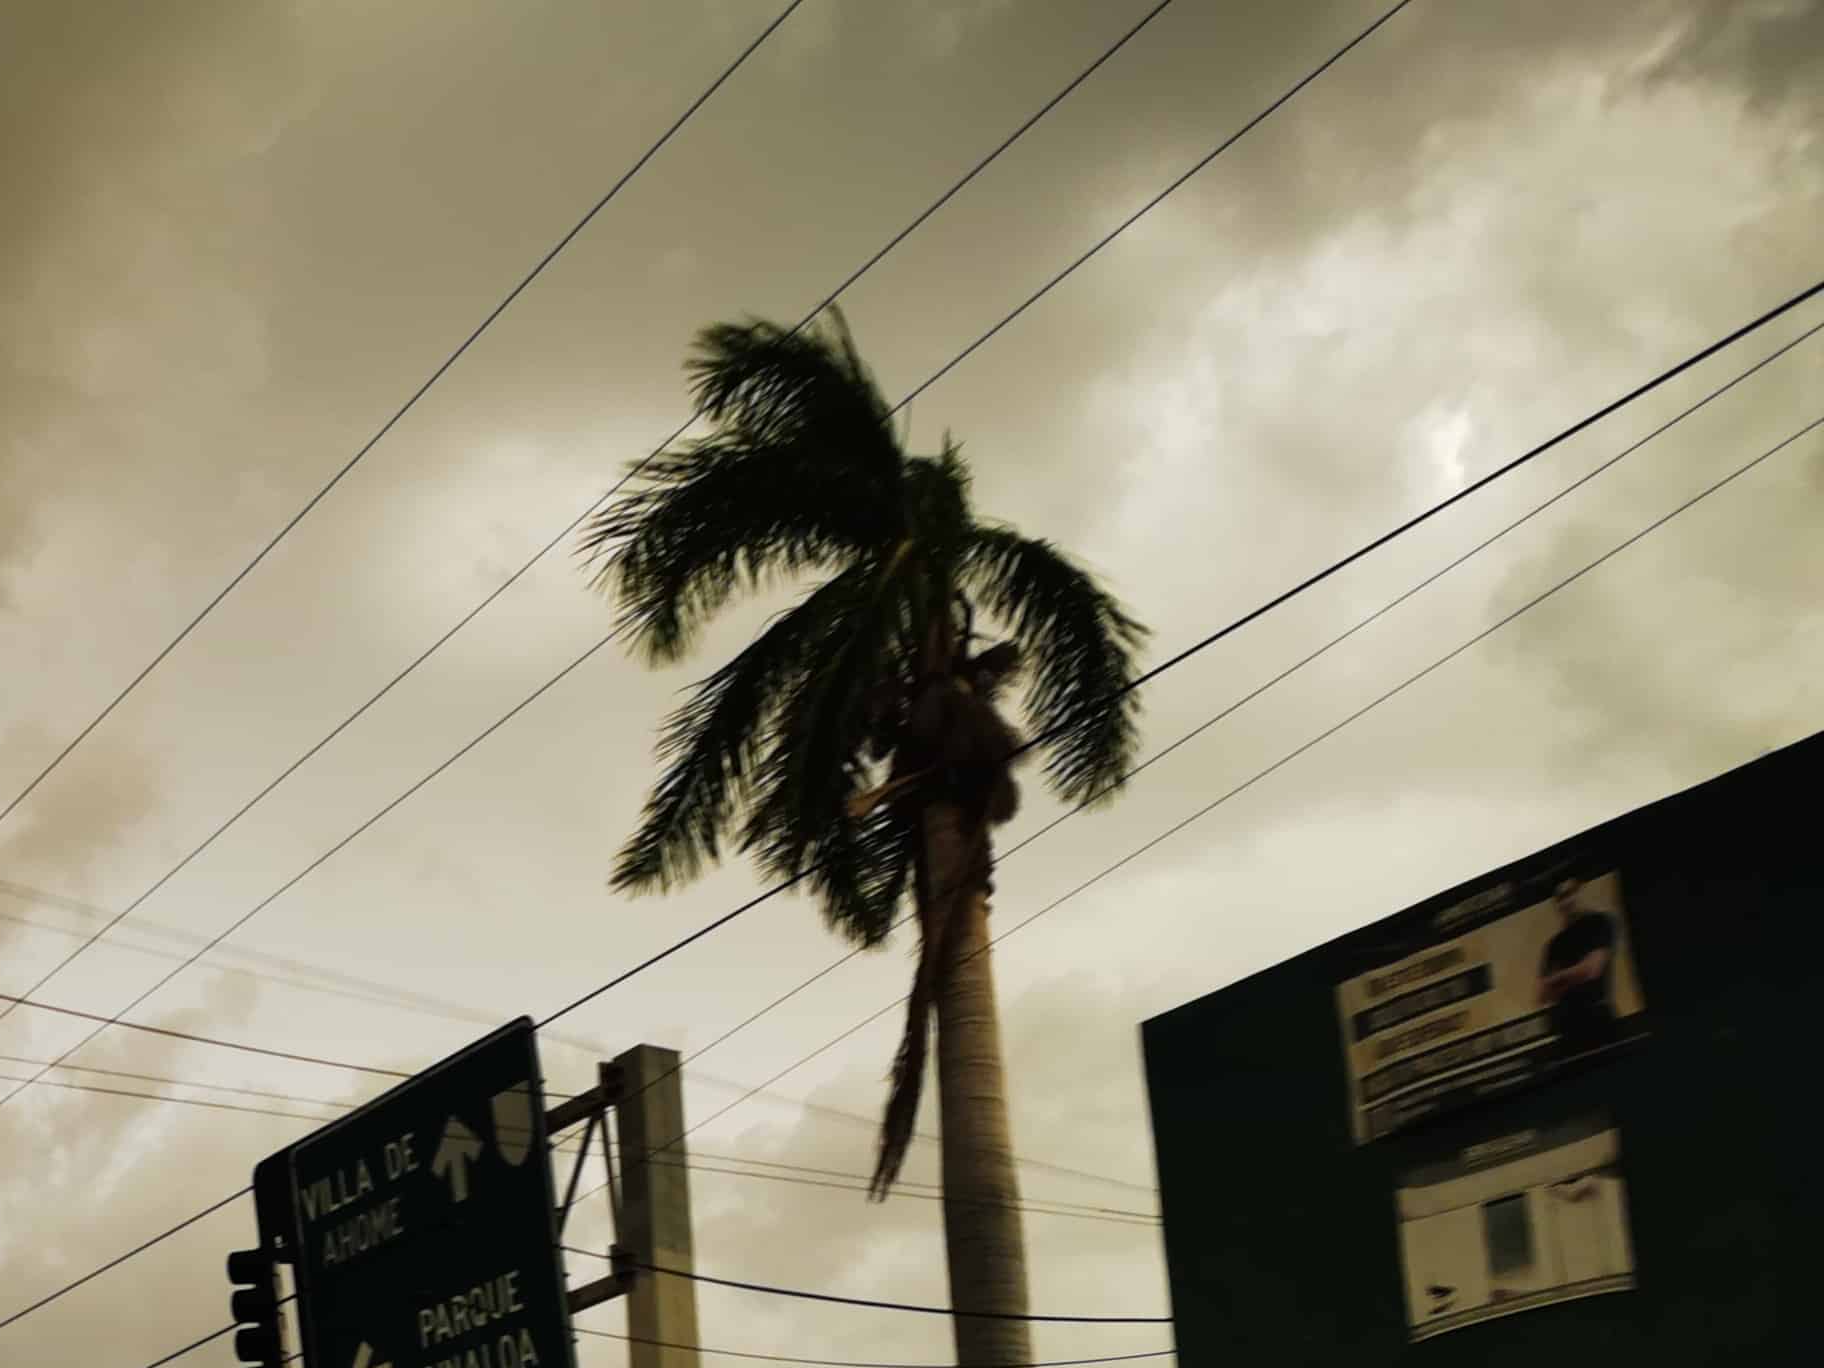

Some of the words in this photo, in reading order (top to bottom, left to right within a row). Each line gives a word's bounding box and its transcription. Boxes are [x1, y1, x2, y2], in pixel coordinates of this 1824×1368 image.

[301, 1159, 374, 1221] VILLA
[384, 1133, 419, 1182] DE
[322, 1199, 404, 1267] AHOME
[418, 1270, 526, 1348] PARQUE
